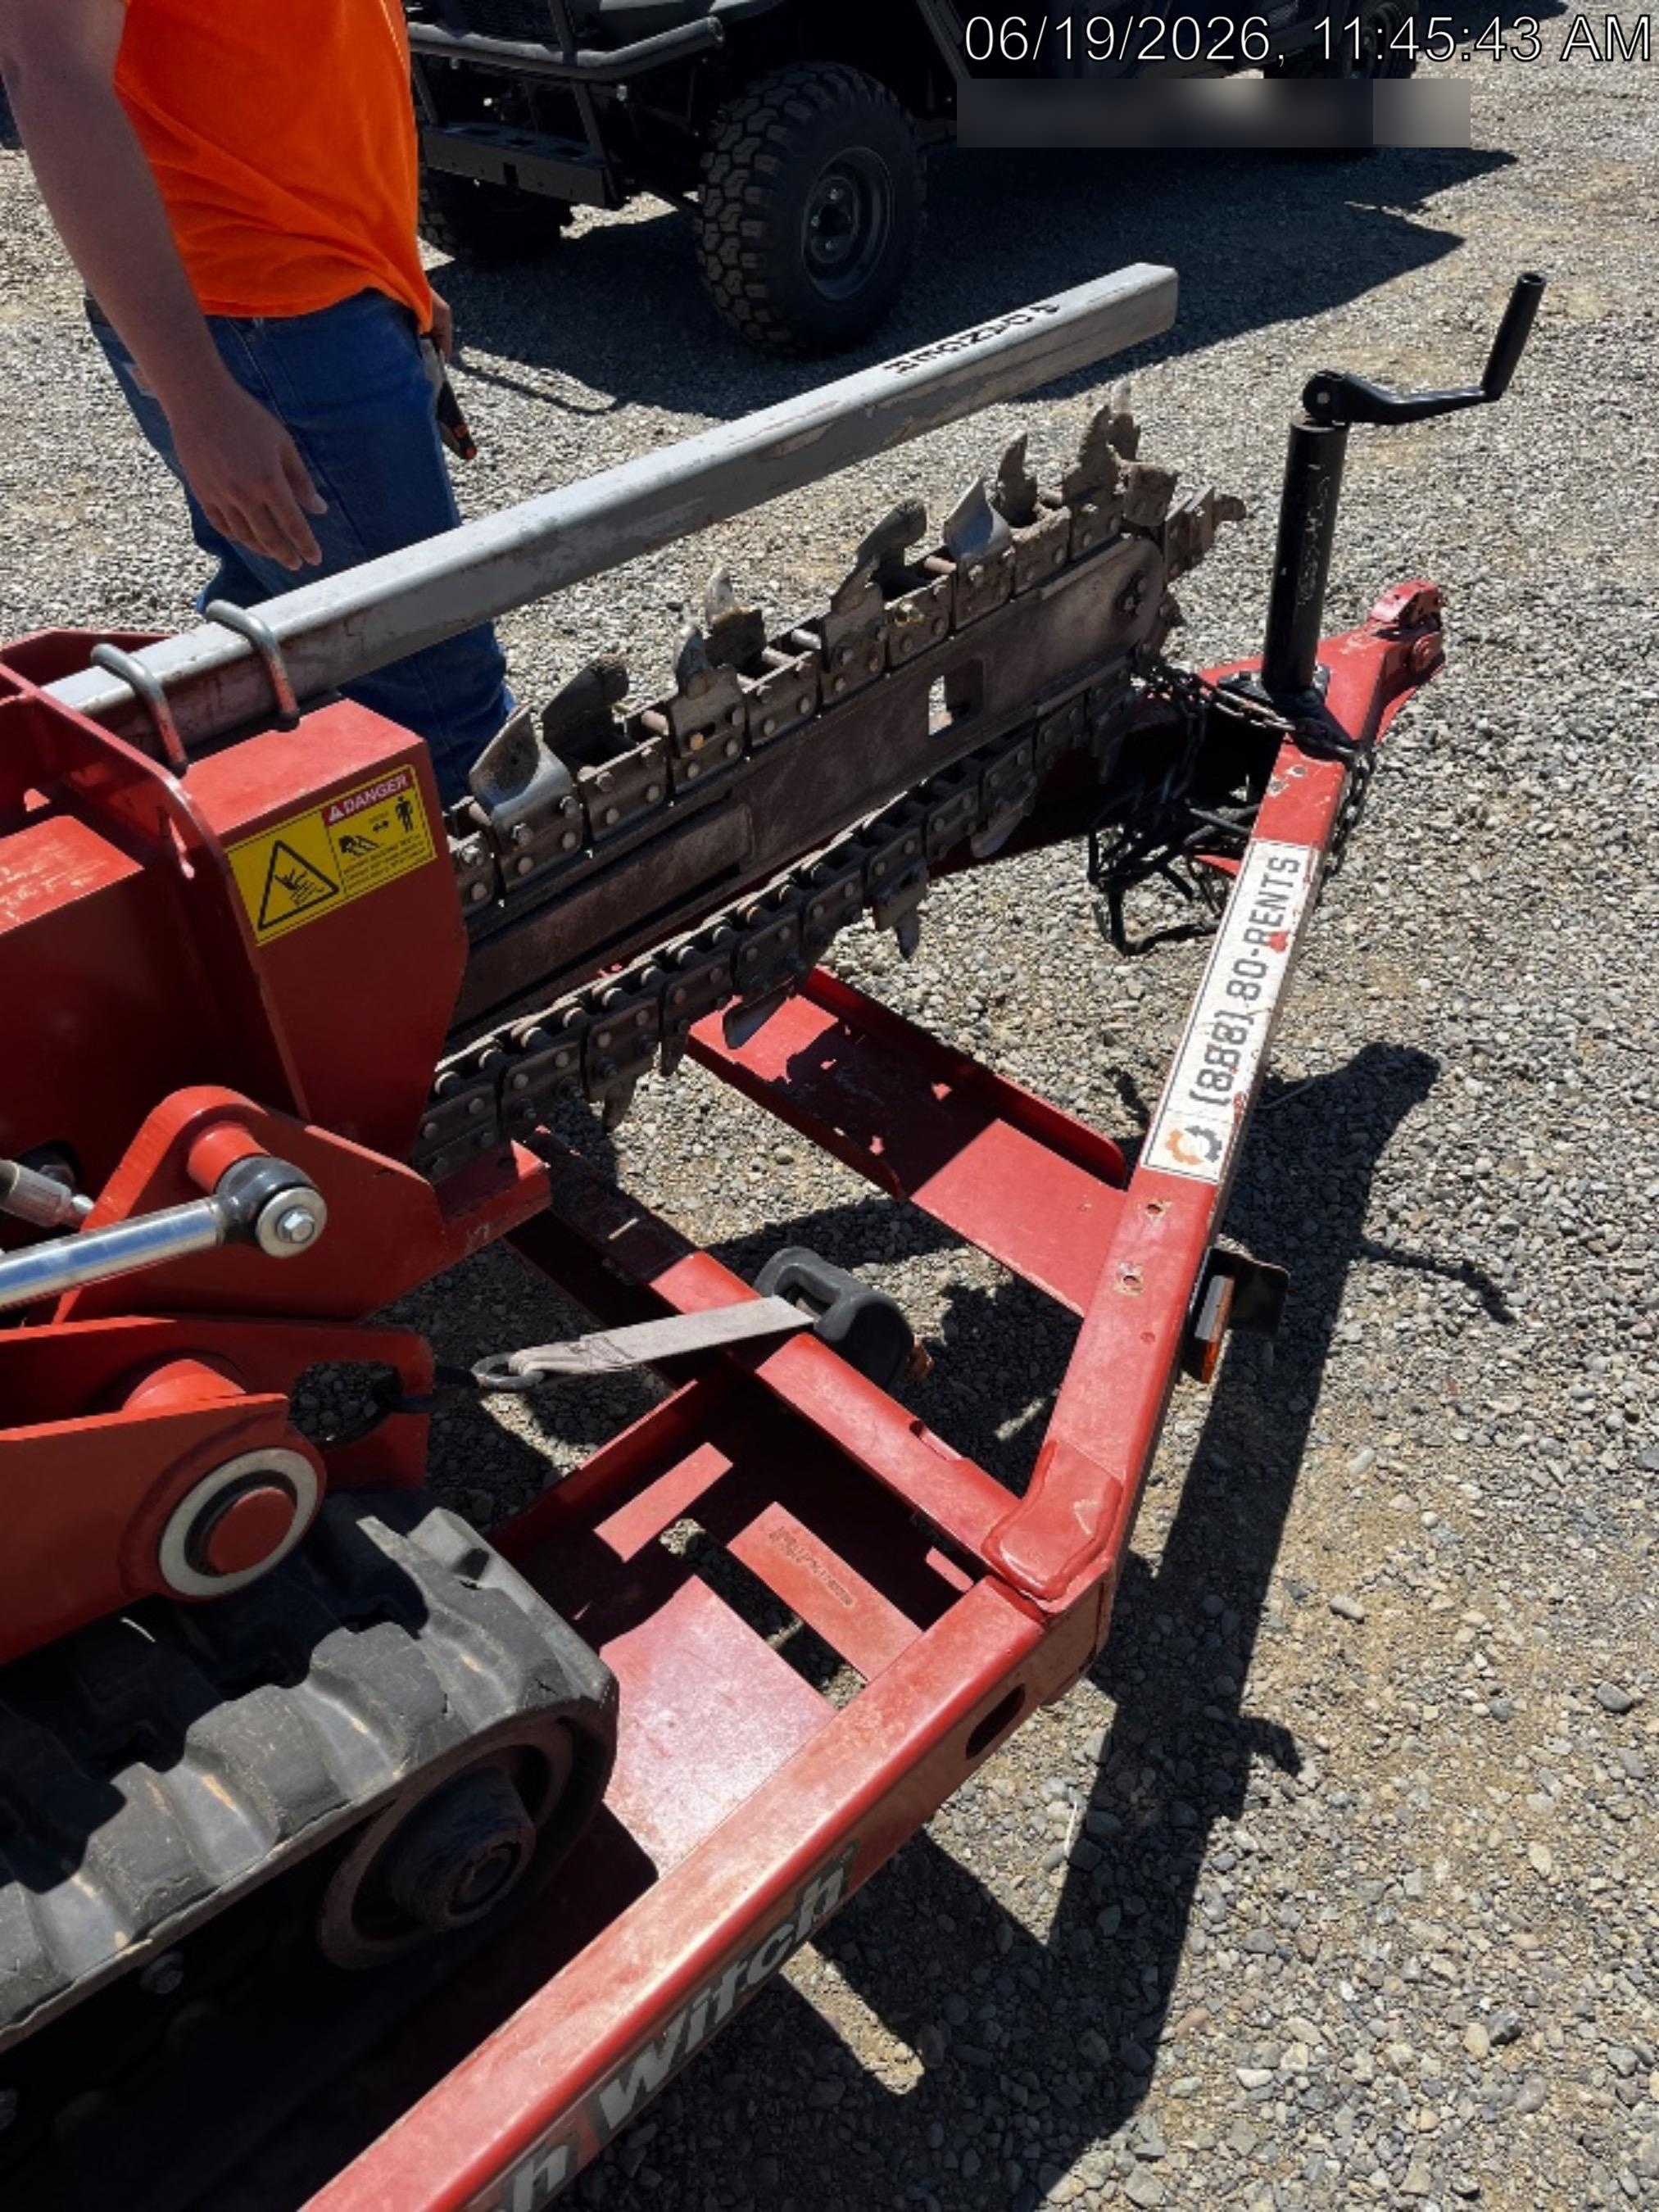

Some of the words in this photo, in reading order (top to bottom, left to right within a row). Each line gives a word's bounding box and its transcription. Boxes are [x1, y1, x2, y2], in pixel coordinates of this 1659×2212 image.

[343, 773, 409, 814] DANGER
[1190, 1009, 1254, 1107] (888)
[1226, 856, 1300, 1001] 80-RENTS
[599, 1866, 845, 2130] Witch
